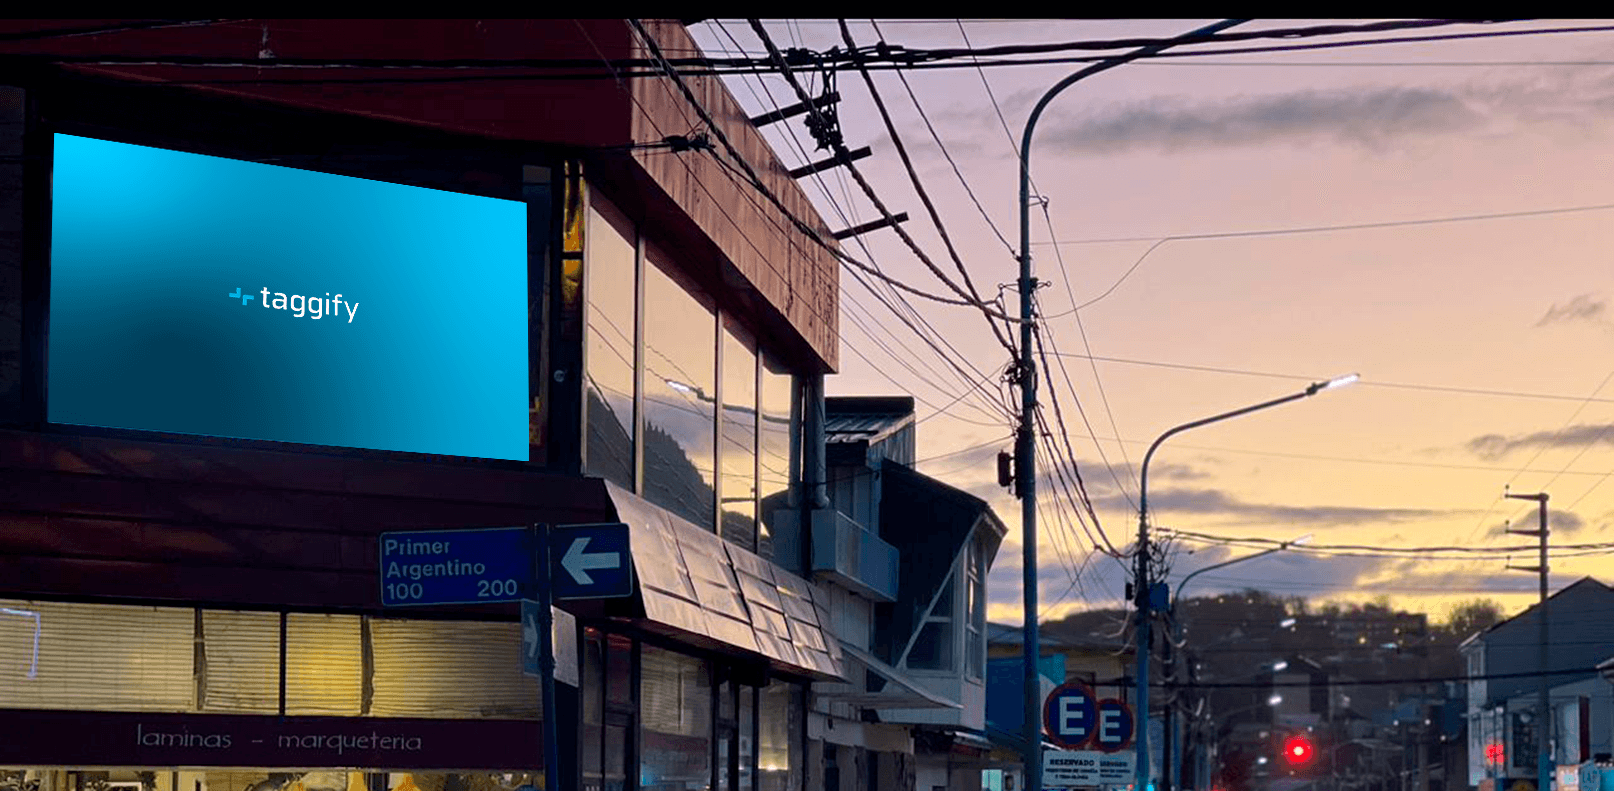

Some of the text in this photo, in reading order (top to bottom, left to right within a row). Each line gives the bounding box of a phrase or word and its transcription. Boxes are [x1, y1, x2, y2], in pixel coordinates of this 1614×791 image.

[260, 286, 360, 324] taggify
[384, 538, 451, 556] Primer
[386, 559, 486, 580] Argentino
[386, 579, 518, 600] 100 200
[1059, 696, 1085, 735] E
[1099, 710, 1121, 742] E
[136, 723, 232, 748] laminas
[278, 731, 422, 755] marqueteria
